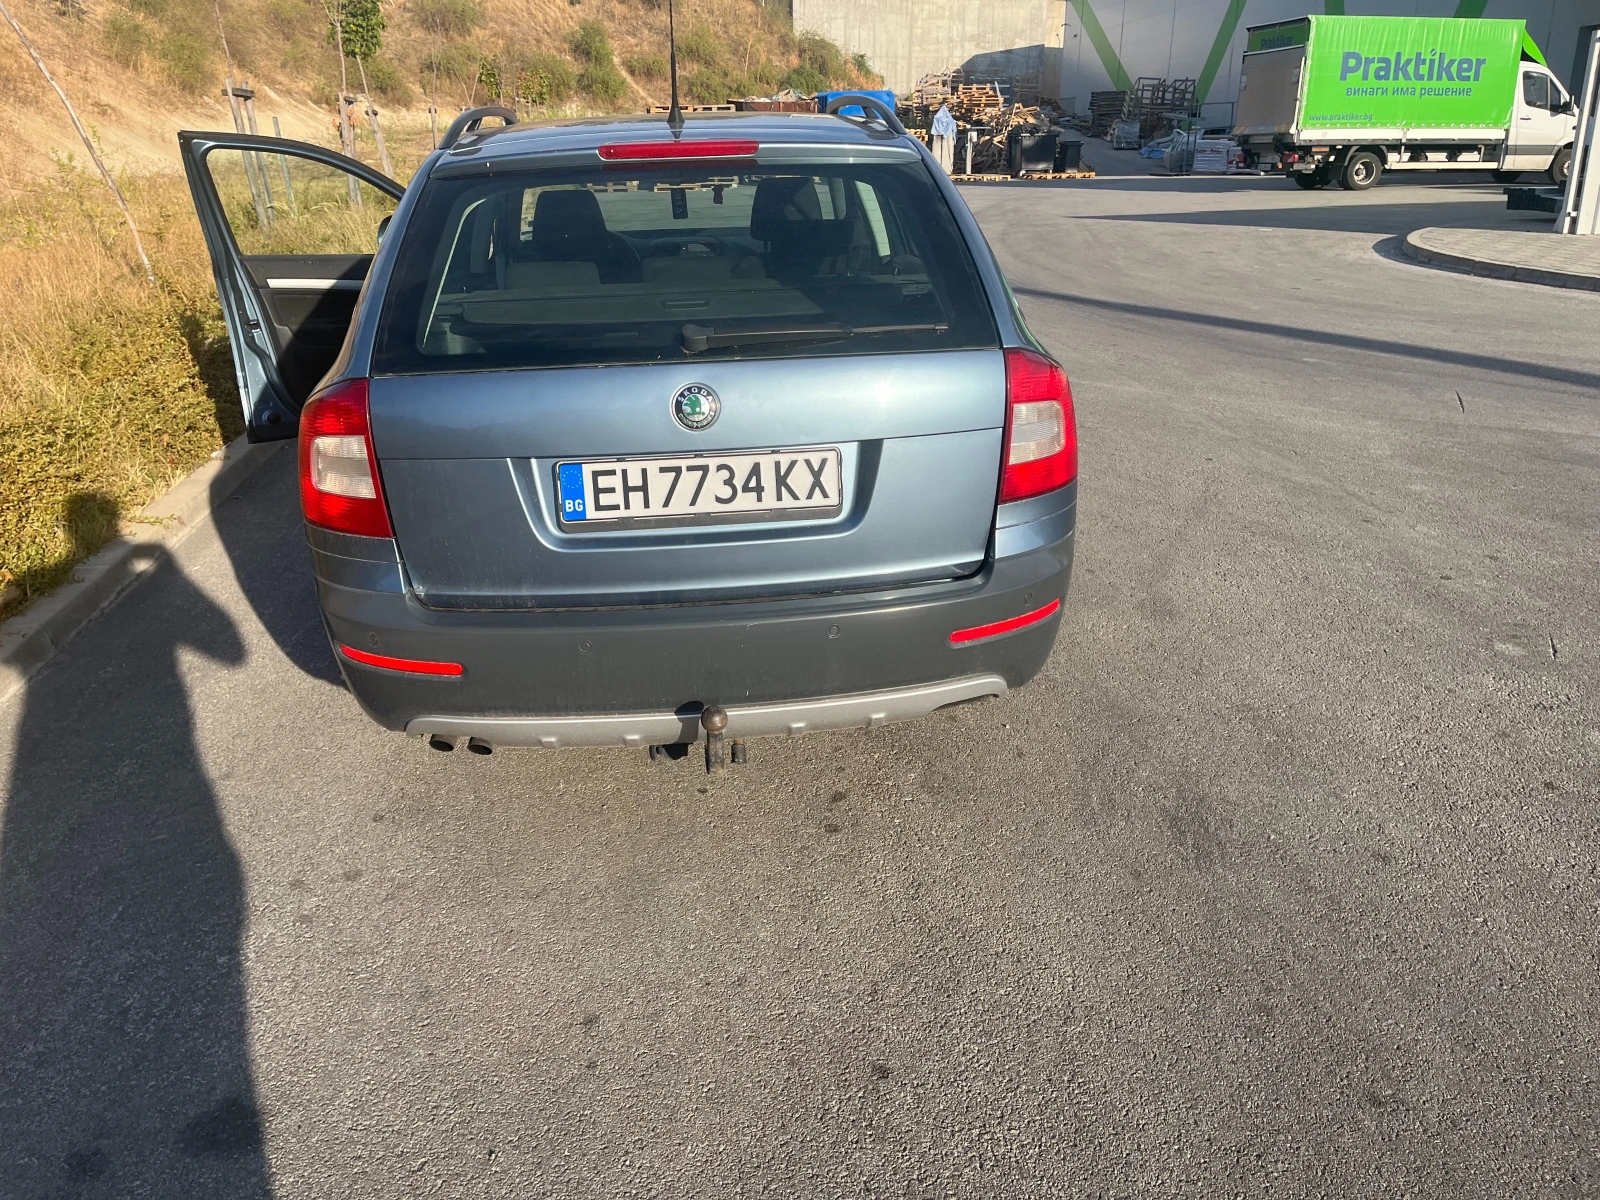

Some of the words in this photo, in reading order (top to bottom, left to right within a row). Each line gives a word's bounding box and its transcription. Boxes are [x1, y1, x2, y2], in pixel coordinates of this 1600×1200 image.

[1339, 49, 1487, 82] Praktiker
[1346, 86, 1389, 97] винаги
[1392, 86, 1417, 97] има
[1419, 87, 1472, 99] решение
[1309, 113, 1373, 122] www.praktiker.bg
[565, 499, 584, 513] BG
